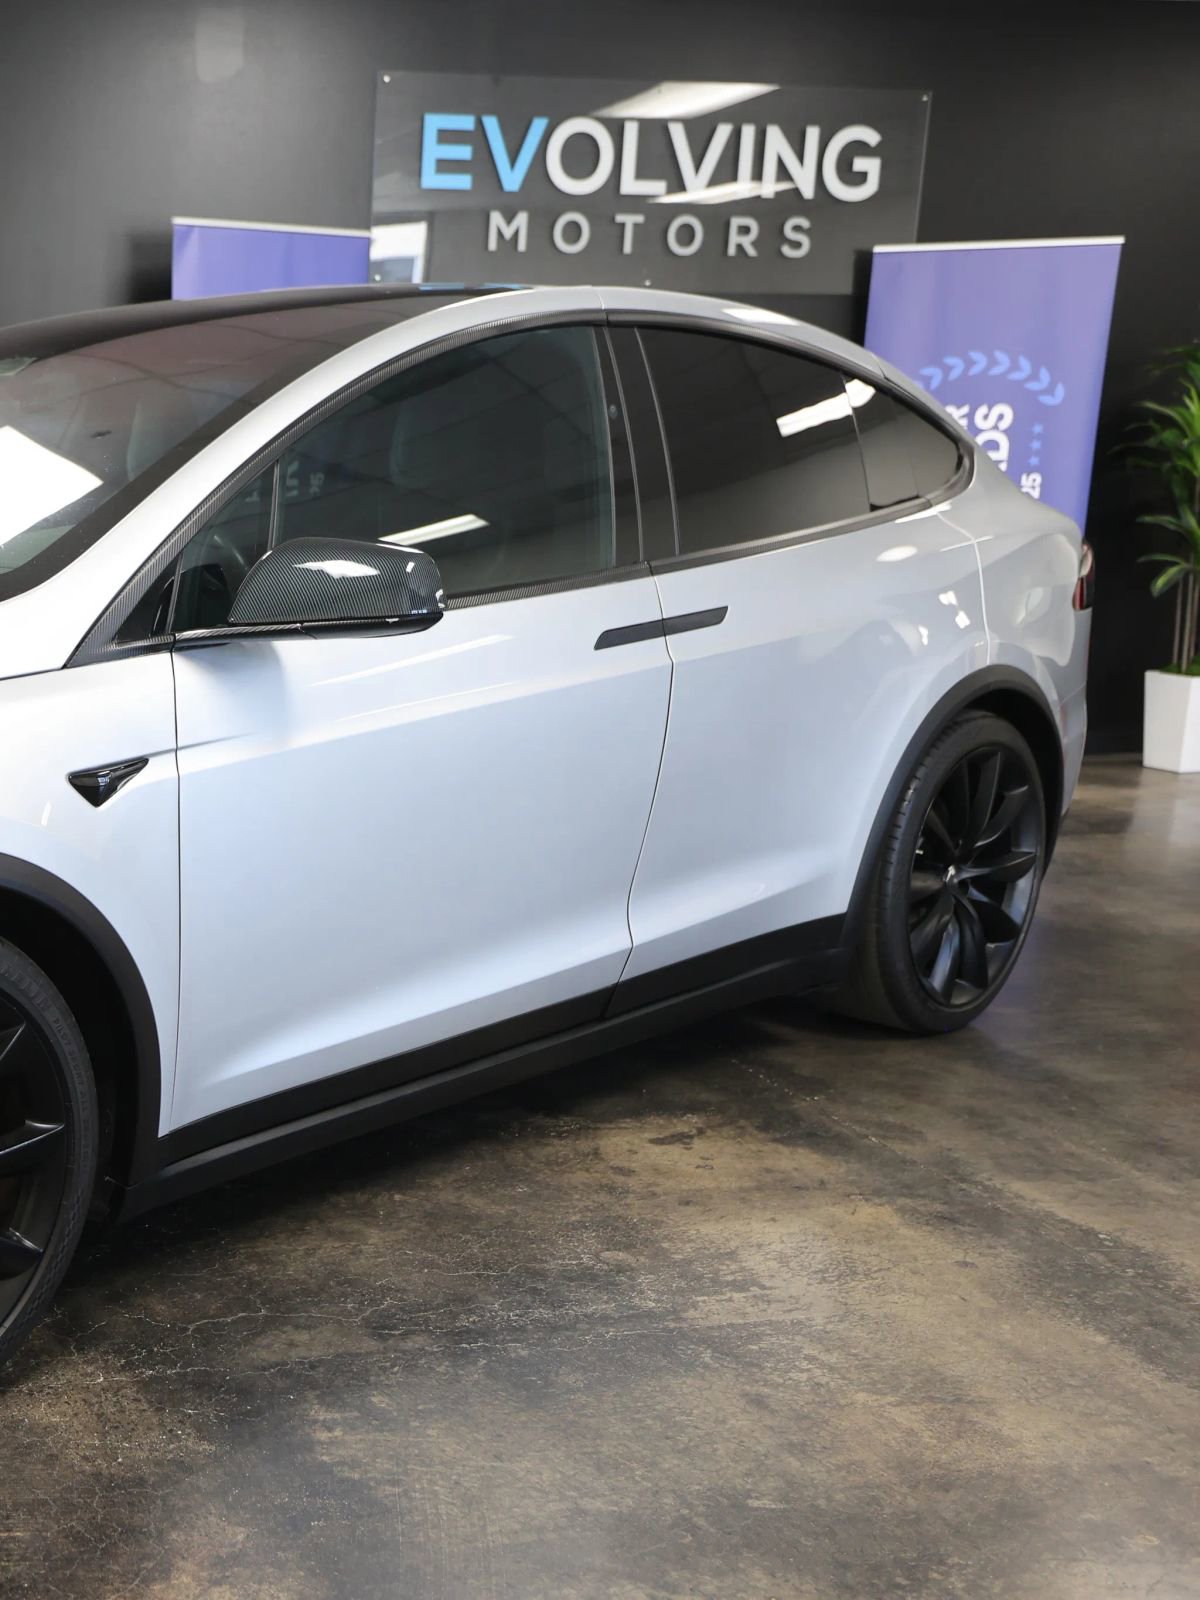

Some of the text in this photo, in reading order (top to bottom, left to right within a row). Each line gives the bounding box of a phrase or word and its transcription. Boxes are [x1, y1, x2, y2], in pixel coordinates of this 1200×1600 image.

[420, 113, 882, 202] EVOLVING
[487, 211, 813, 258] MOTORS
[974, 402, 1013, 472] DS
